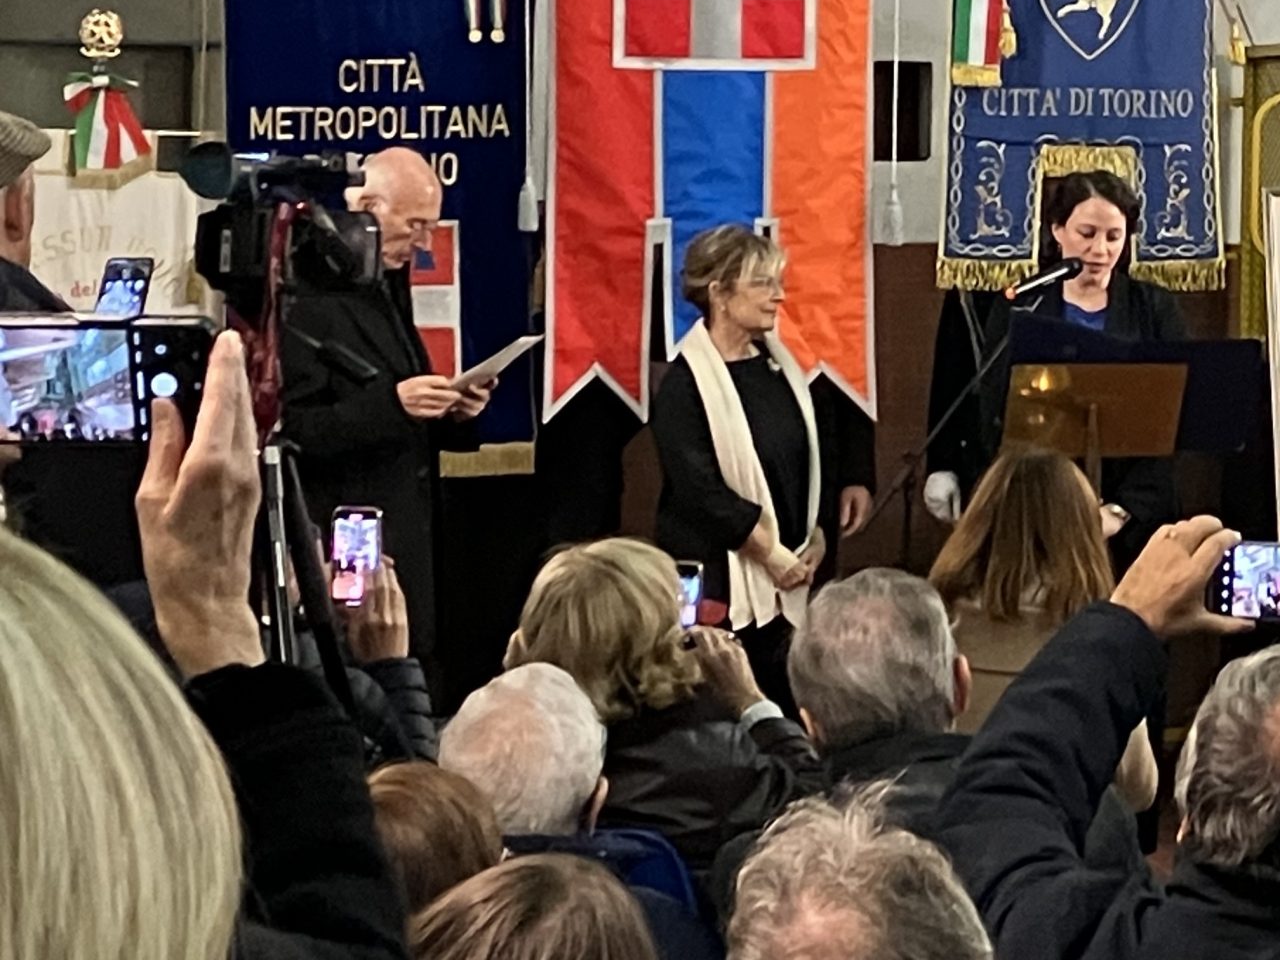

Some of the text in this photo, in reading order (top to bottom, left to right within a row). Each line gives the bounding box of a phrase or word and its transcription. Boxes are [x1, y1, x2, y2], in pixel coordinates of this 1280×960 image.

[338, 51, 425, 92] CITTÀ
[249, 103, 510, 140] METROPOLITANA
[982, 88, 1194, 118] CITTA' DI TORINO
